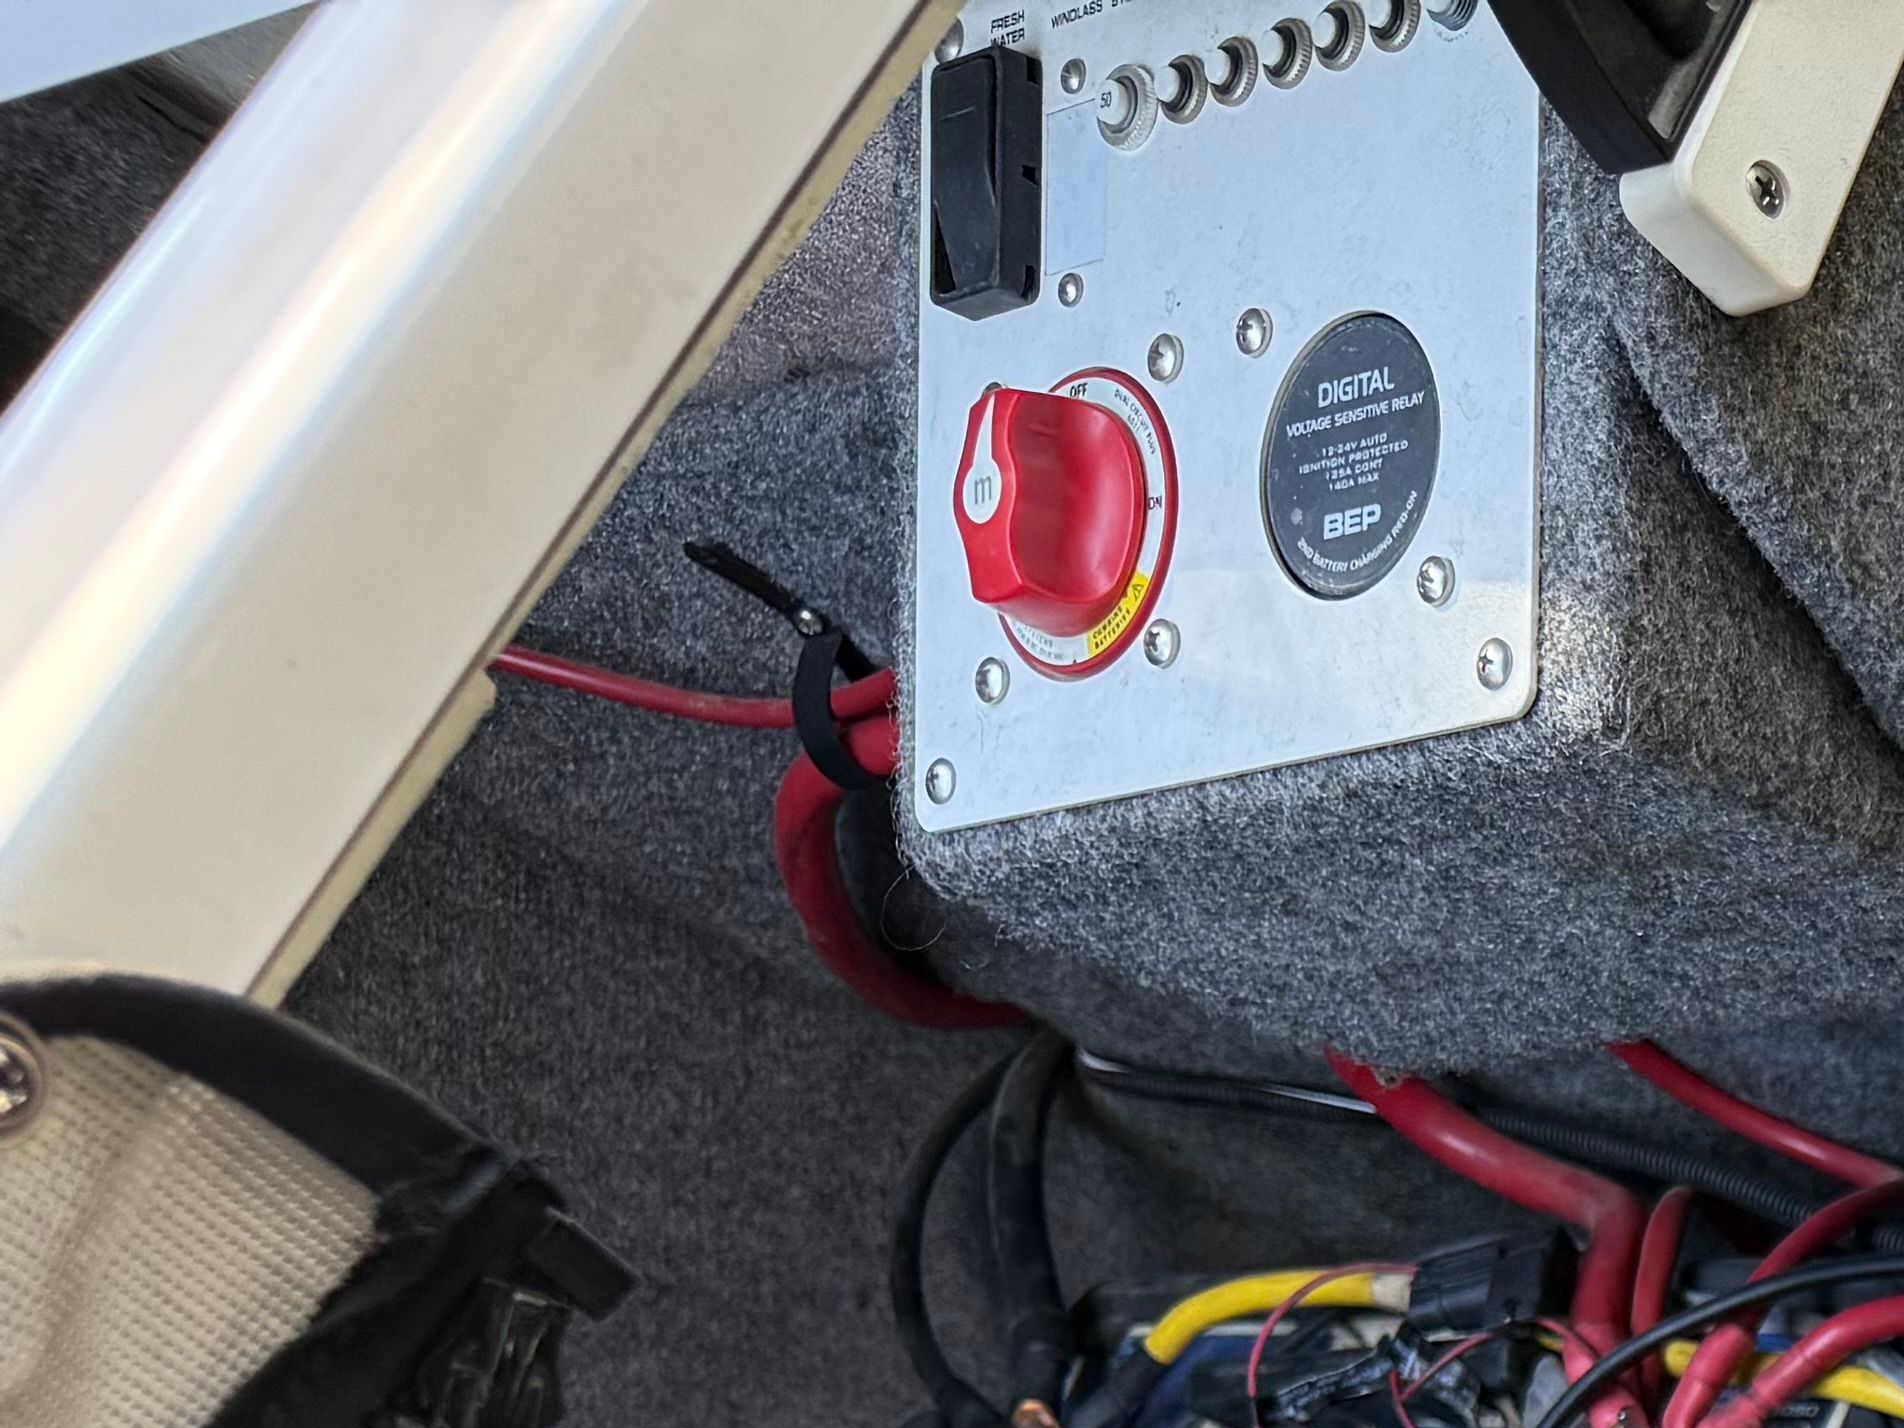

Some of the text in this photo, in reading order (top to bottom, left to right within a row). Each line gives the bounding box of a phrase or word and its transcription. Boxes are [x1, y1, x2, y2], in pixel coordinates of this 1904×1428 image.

[991, 9, 1025, 33] FRESH
[1070, 383, 1088, 398] OFF
[1318, 366, 1395, 408] DIGITAL
[1286, 391, 1425, 437] VOLTAGE SENSITIVE RELAY
[1148, 495, 1162, 509] ON
[1323, 504, 1382, 540] BEP
